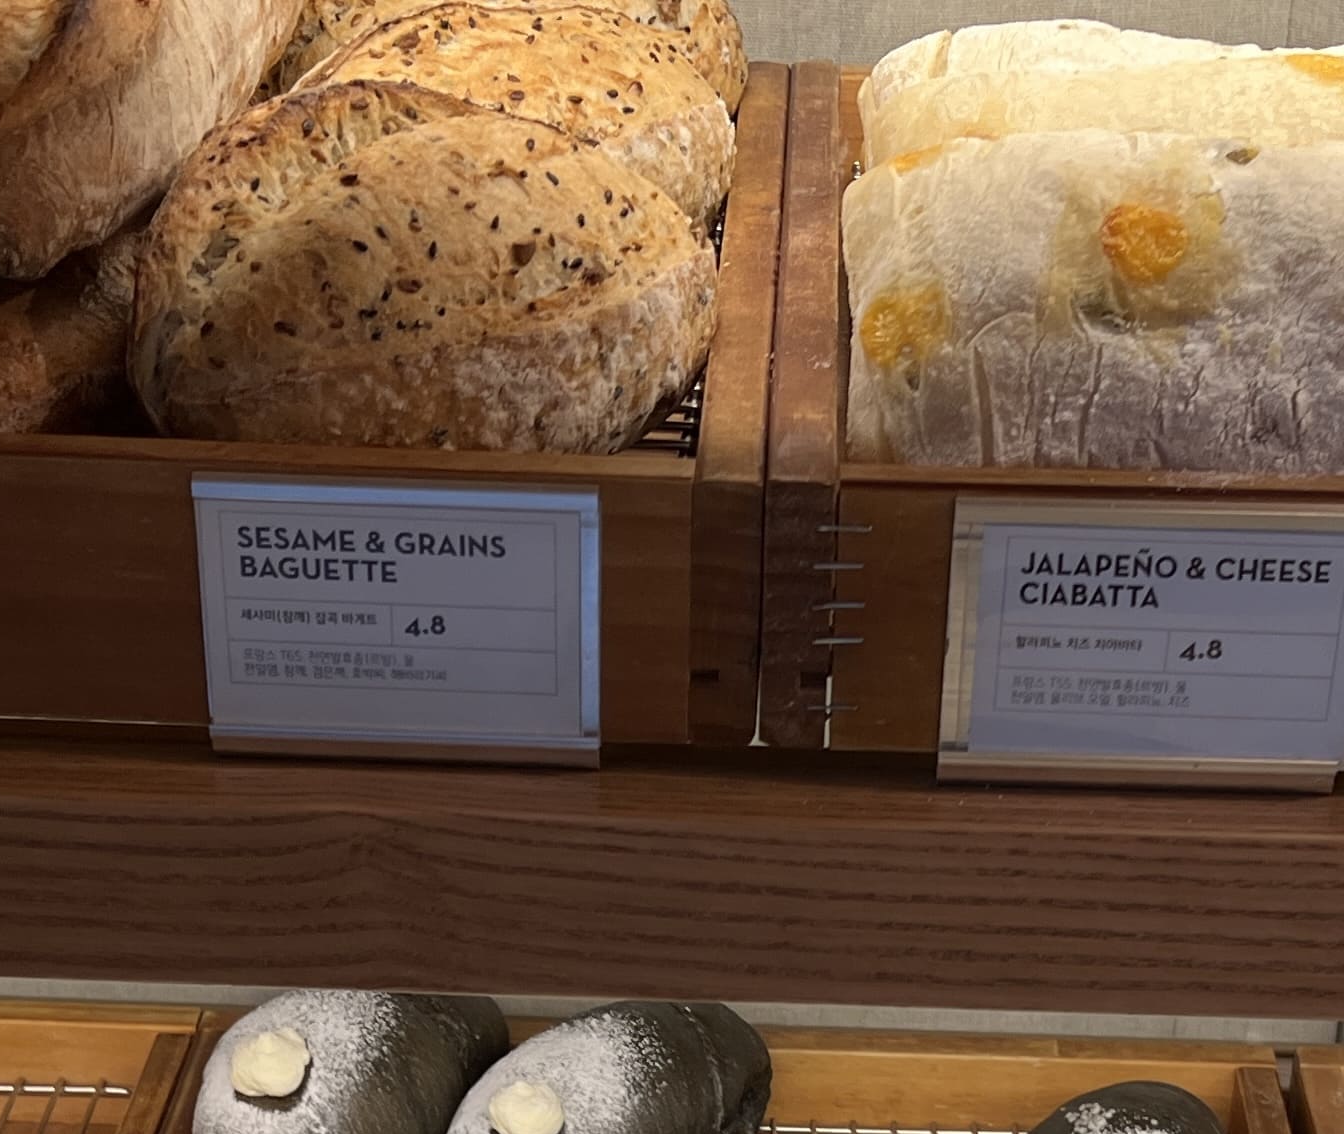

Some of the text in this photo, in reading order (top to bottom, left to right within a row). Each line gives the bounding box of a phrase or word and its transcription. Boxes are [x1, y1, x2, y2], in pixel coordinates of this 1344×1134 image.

[237, 526, 506, 558] SESAME & GRAINS
[240, 556, 398, 583] BAGUETTE
[1021, 549, 1332, 583] JALAPEÑO & CHEESE
[1020, 582, 1159, 608] CIABATTA
[341, 613, 378, 625] 바게트
[404, 615, 446, 637] 4.8
[1179, 639, 1223, 661] 4.8
